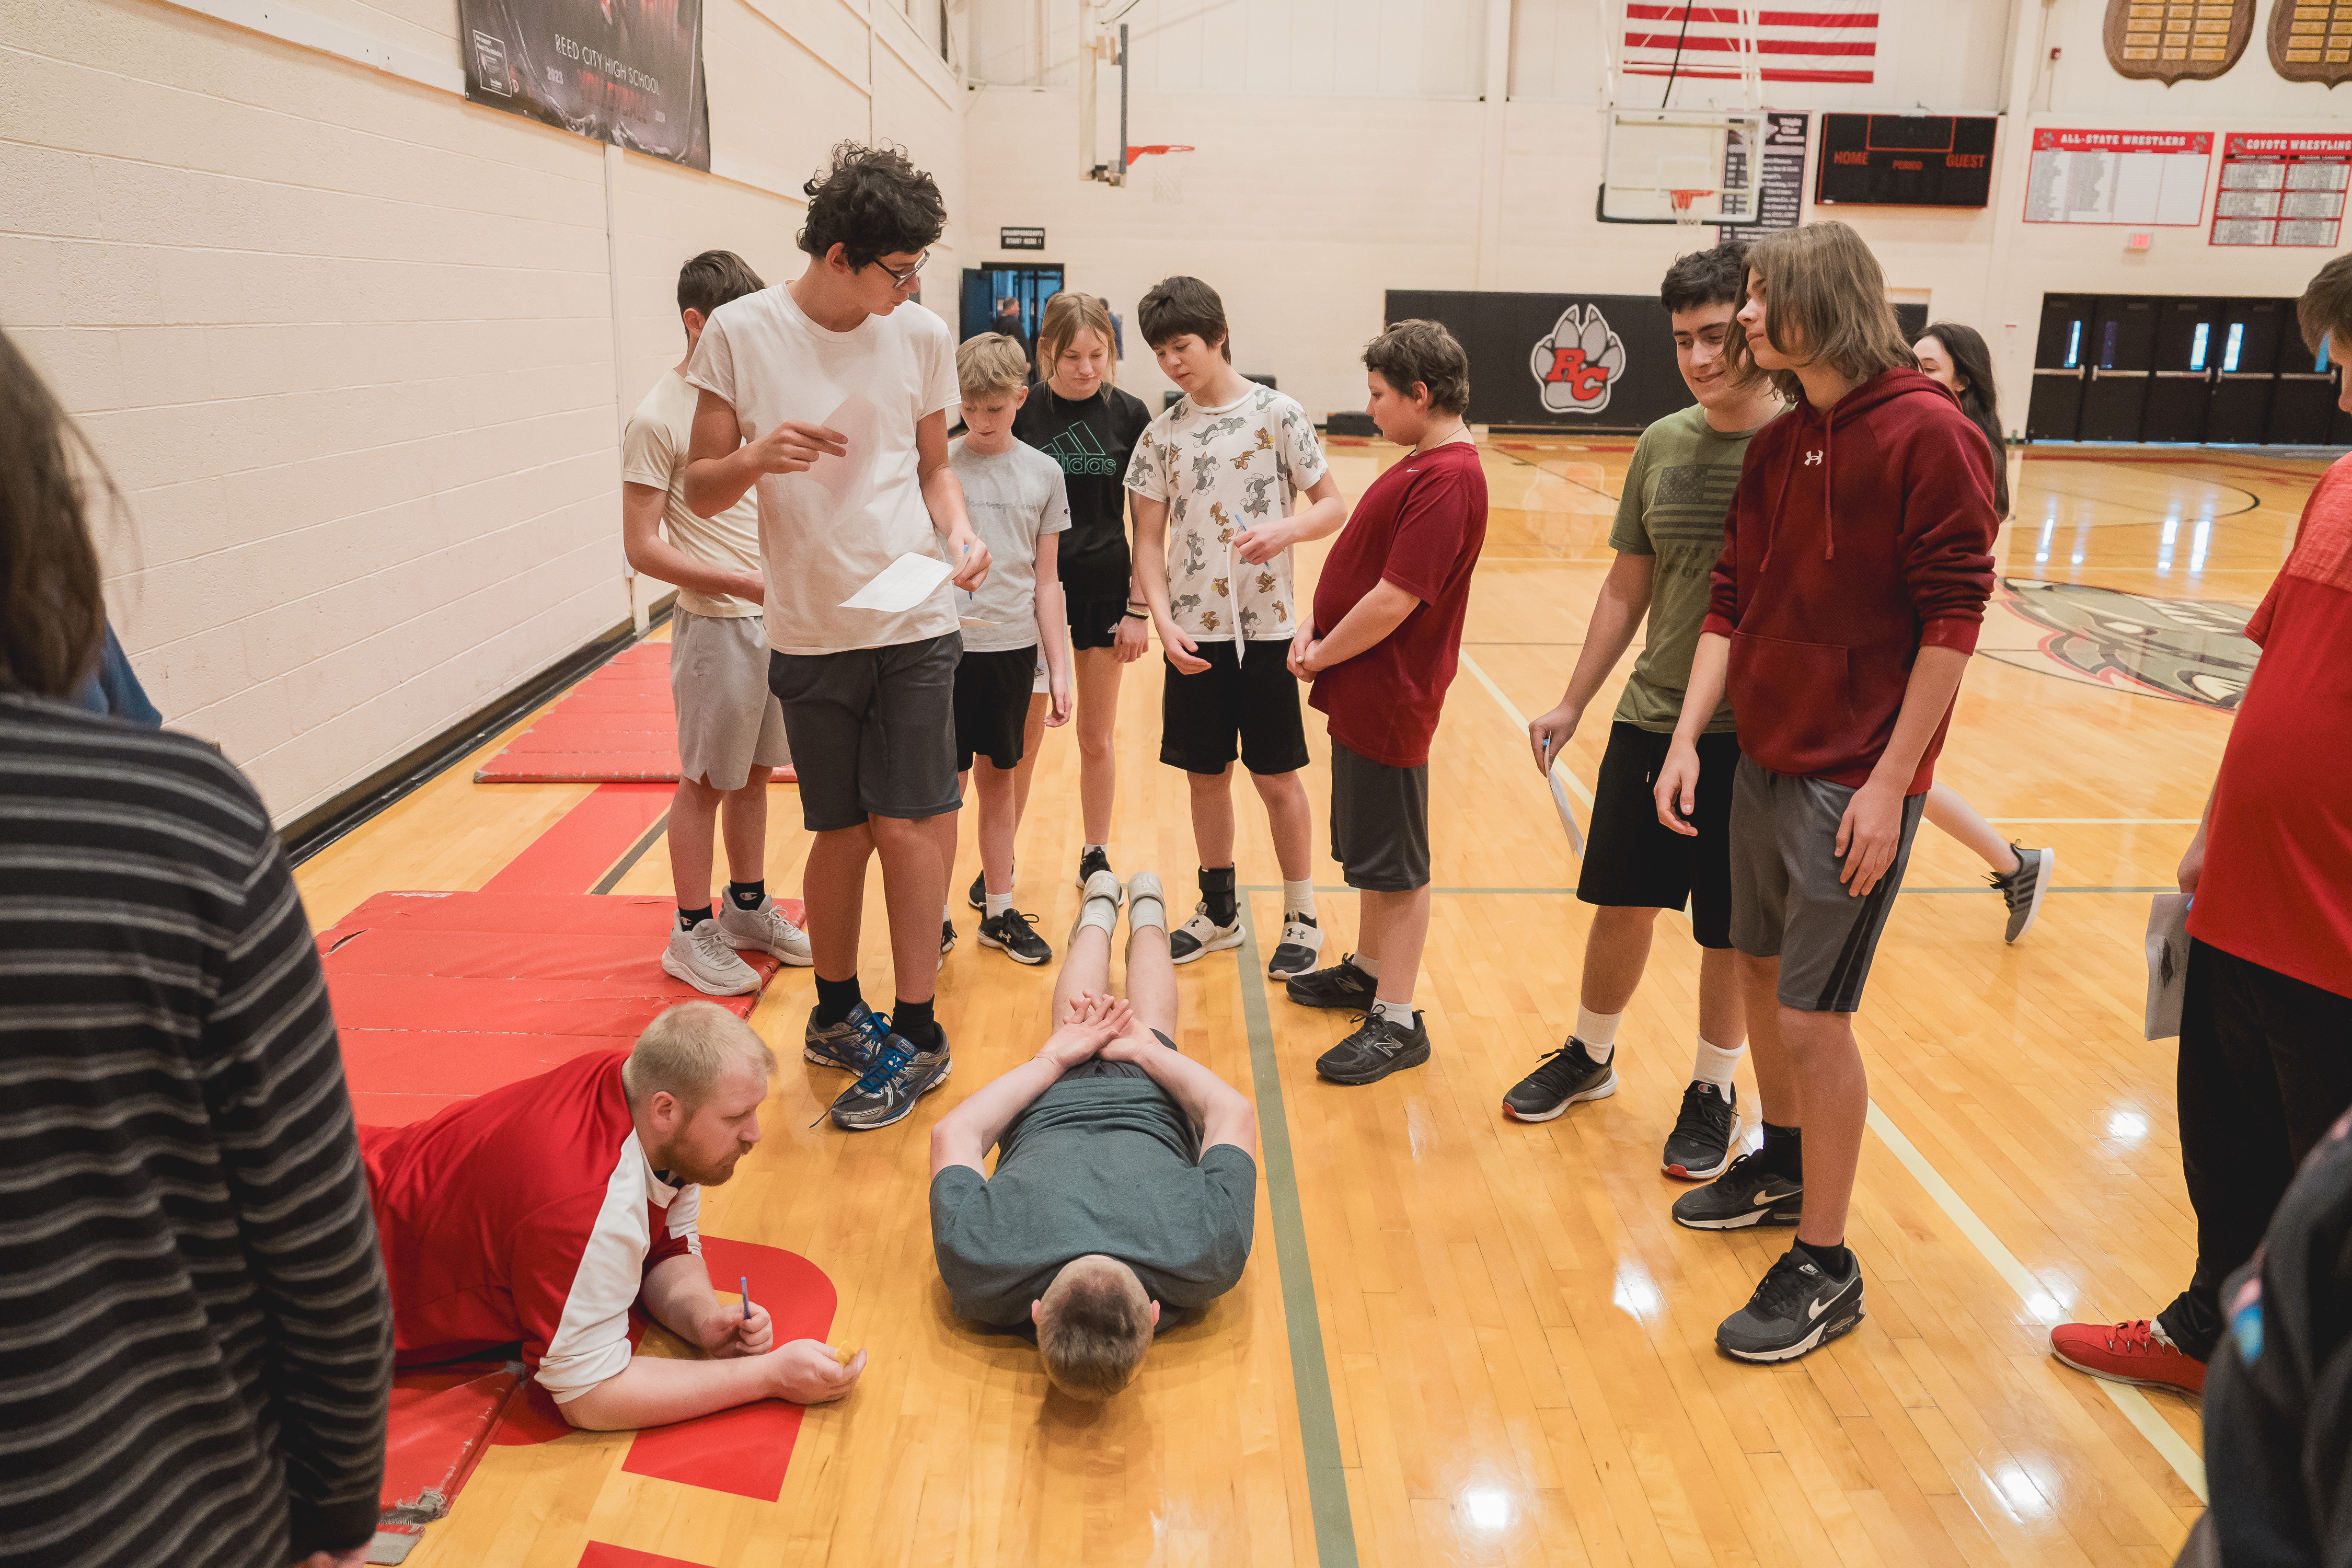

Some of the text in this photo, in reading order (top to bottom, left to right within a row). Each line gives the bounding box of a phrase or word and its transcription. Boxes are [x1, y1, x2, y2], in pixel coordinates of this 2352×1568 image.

[555, 33, 660, 96] REED CITY HIGH SCHOOL
[546, 66, 563, 85] 2023
[2060, 133, 2186, 146] ALL-STATE WRESTLERS
[2246, 139, 2352, 151] COYOTE WRESTLING
[1834, 151, 1986, 168] HOME GUEST
[1805, 1263, 1819, 1274] NIKE
